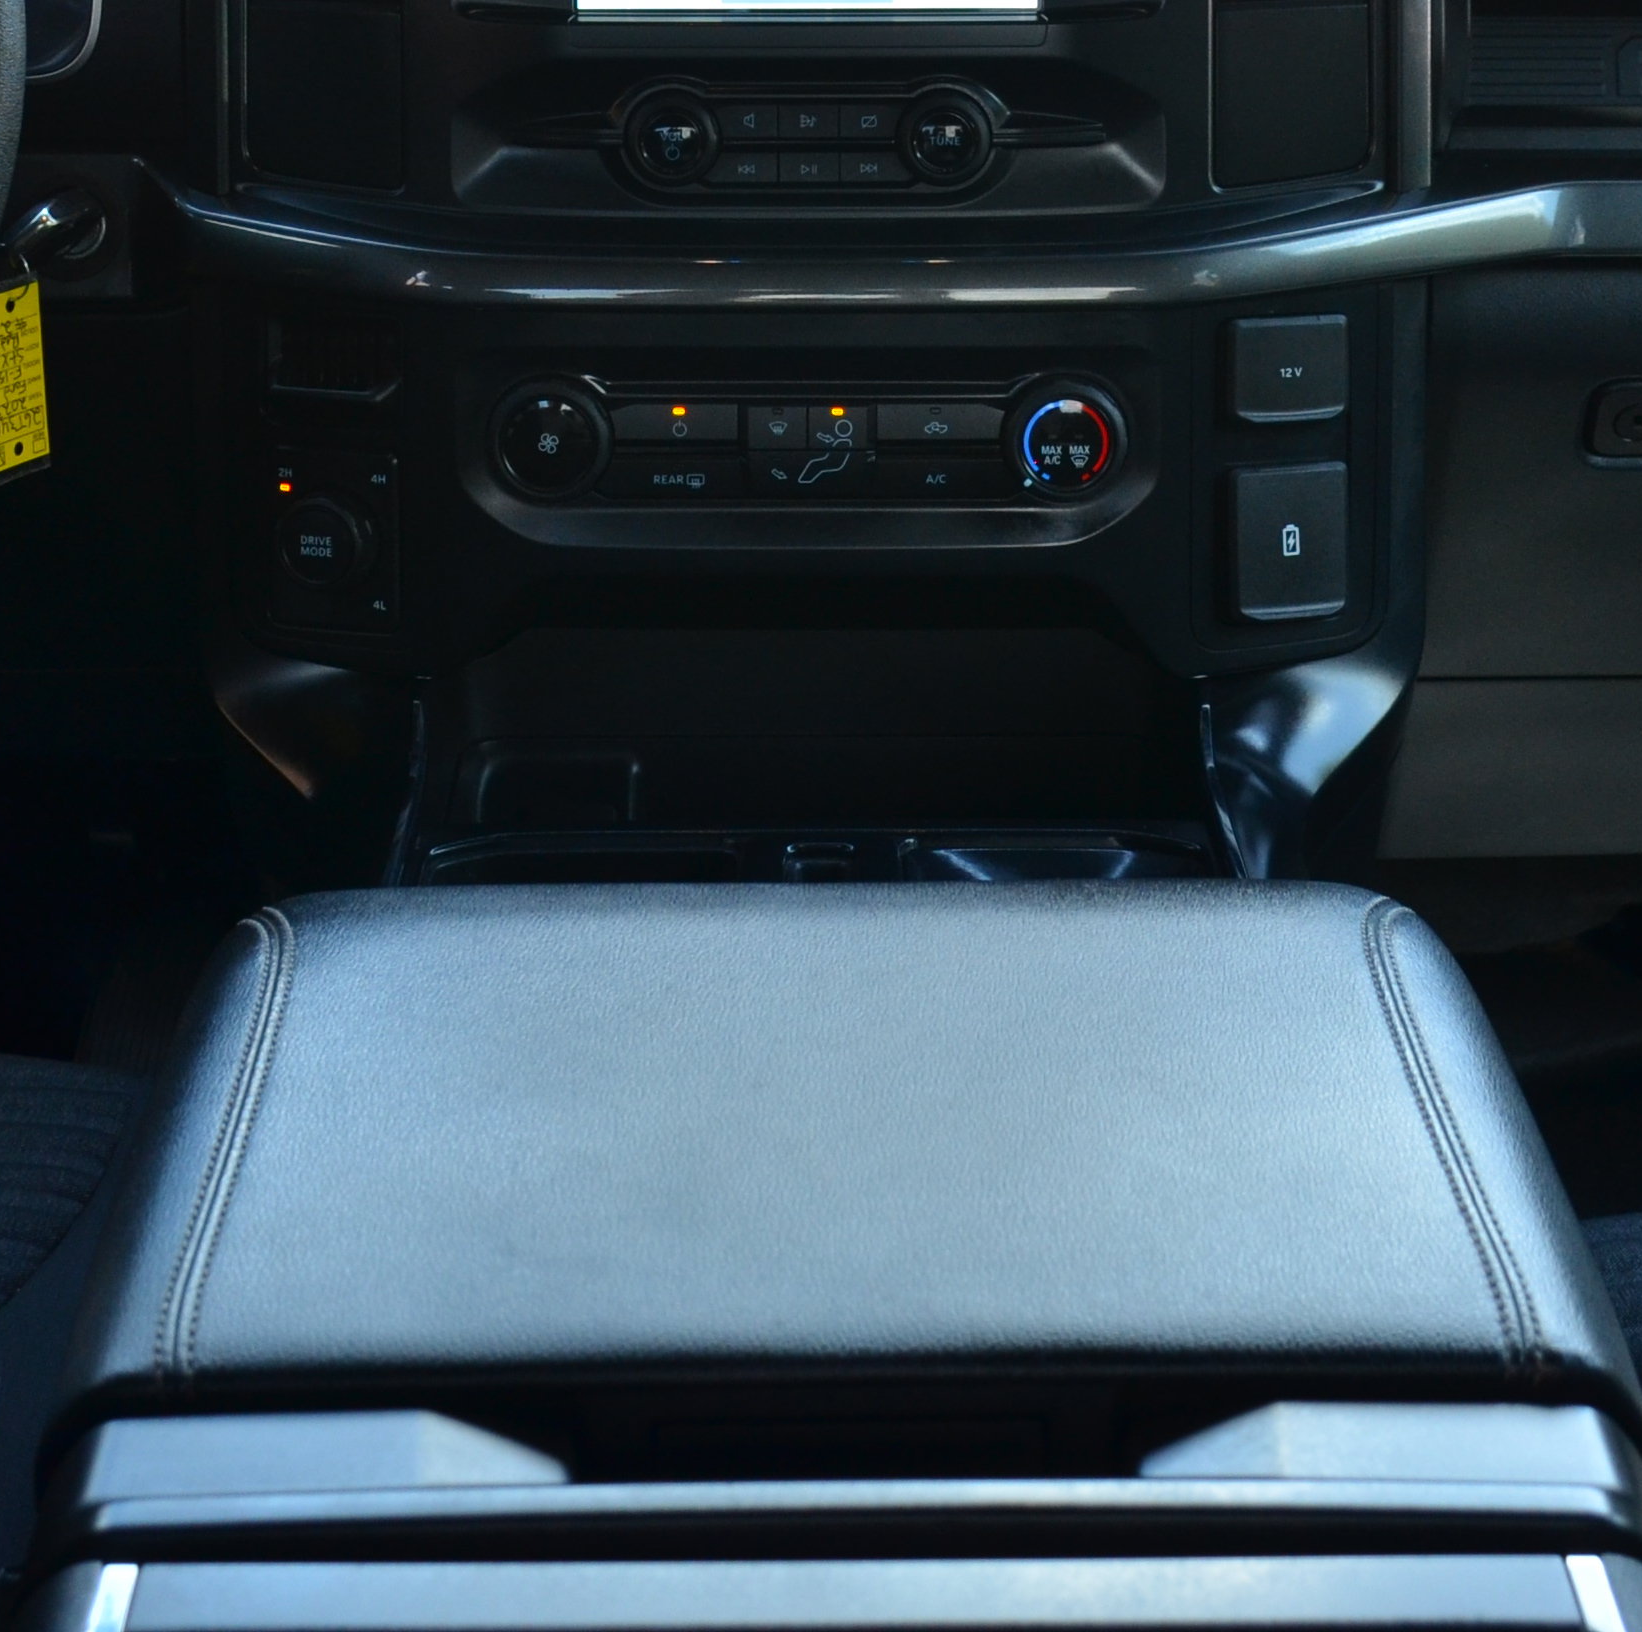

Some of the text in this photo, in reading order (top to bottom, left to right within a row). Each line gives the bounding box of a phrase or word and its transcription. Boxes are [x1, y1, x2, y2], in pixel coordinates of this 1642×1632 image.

[929, 136, 962, 146] TUNE
[1041, 445, 1063, 455] MAX
[1069, 445, 1090, 455] MAX
[1044, 455, 1061, 465] A/C
[278, 467, 293, 477] 2H
[370, 474, 386, 484] 4H
[653, 475, 683, 484] REAR
[926, 473, 947, 484] A/C
[300, 535, 332, 546] DRIVE
[300, 547, 332, 557] MODE
[373, 600, 387, 610] 4L
